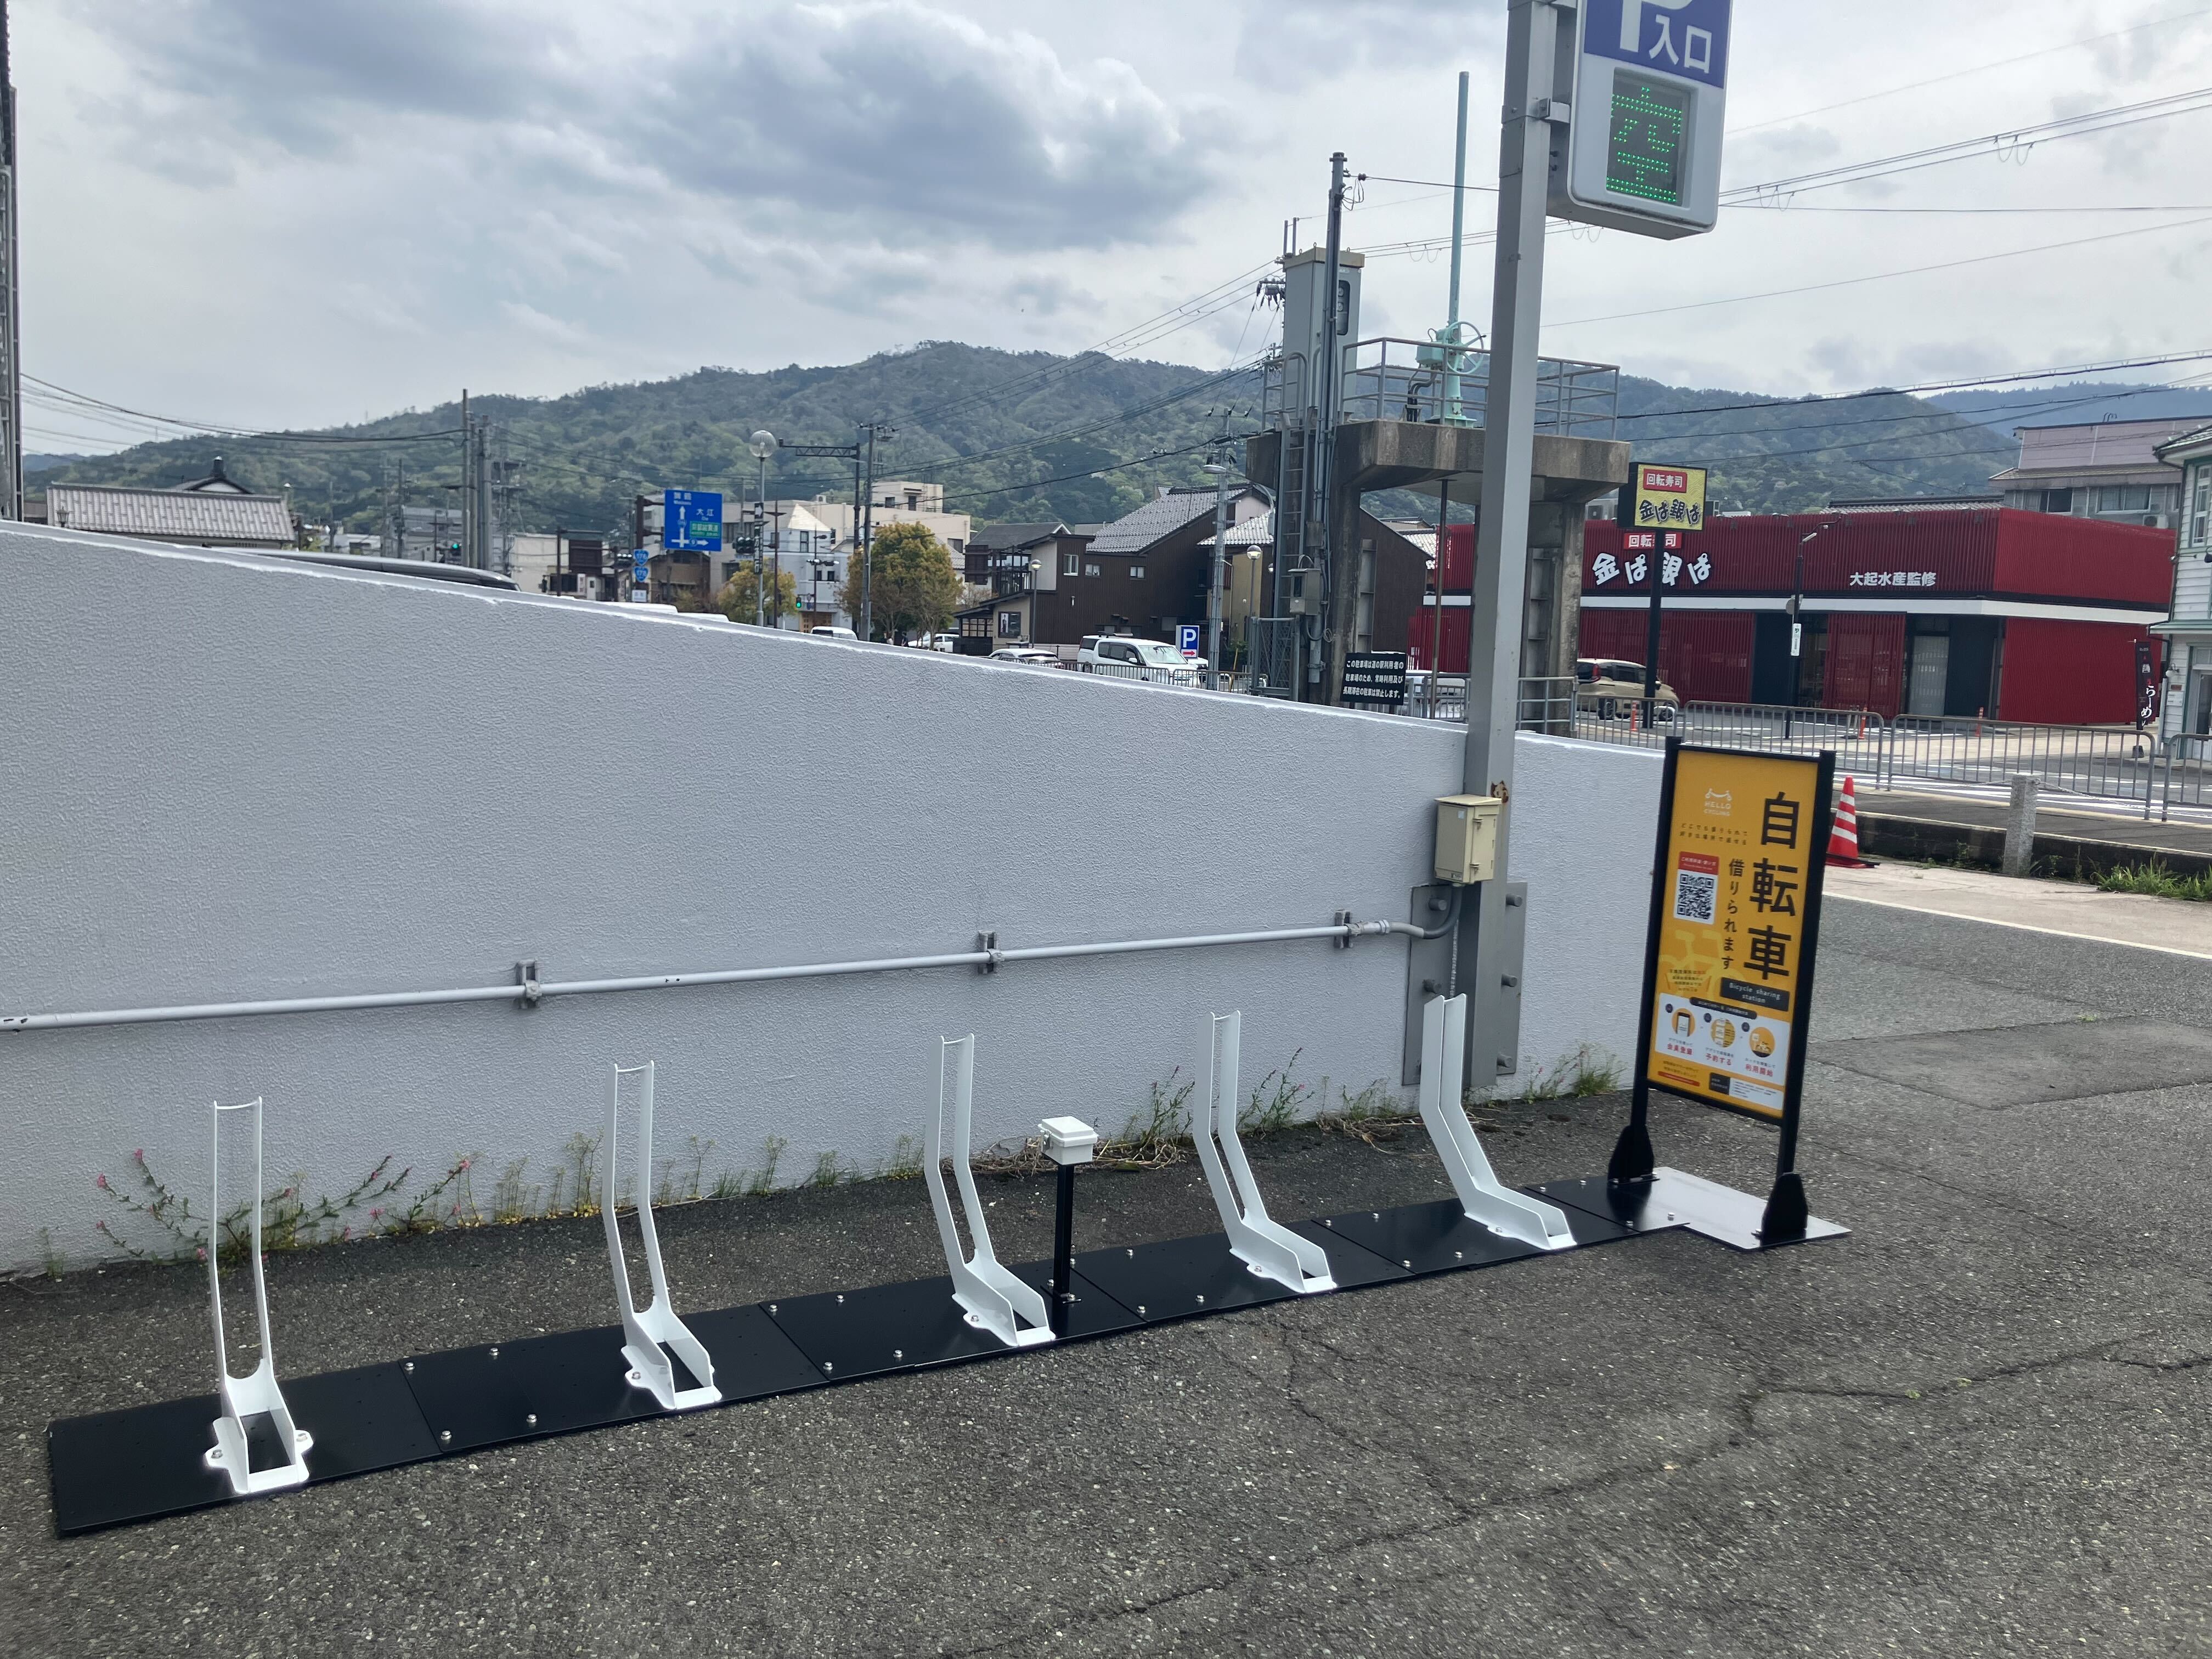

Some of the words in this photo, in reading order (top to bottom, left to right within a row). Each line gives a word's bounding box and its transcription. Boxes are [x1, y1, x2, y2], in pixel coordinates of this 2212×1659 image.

[1649, 14, 1712, 74] 入口
[1605, 86, 1682, 203] 空
[1647, 473, 1683, 488] 回転寿司
[1639, 498, 1700, 525] 金ぱ銀ぱ
[1628, 534, 1677, 548] 回転司
[1849, 572, 1937, 586] 大起水産監修
[1183, 628, 1197, 648] P
[1705, 800, 1731, 810] HELLO
[1743, 791, 1800, 980] 自転車
[1722, 858, 1746, 970] 借りられます
[1729, 982, 1753, 992] Bicycle
[1756, 989, 1781, 1001] sharing
[1742, 994, 1765, 1003] station
[1705, 1053, 1732, 1066] 予約する
